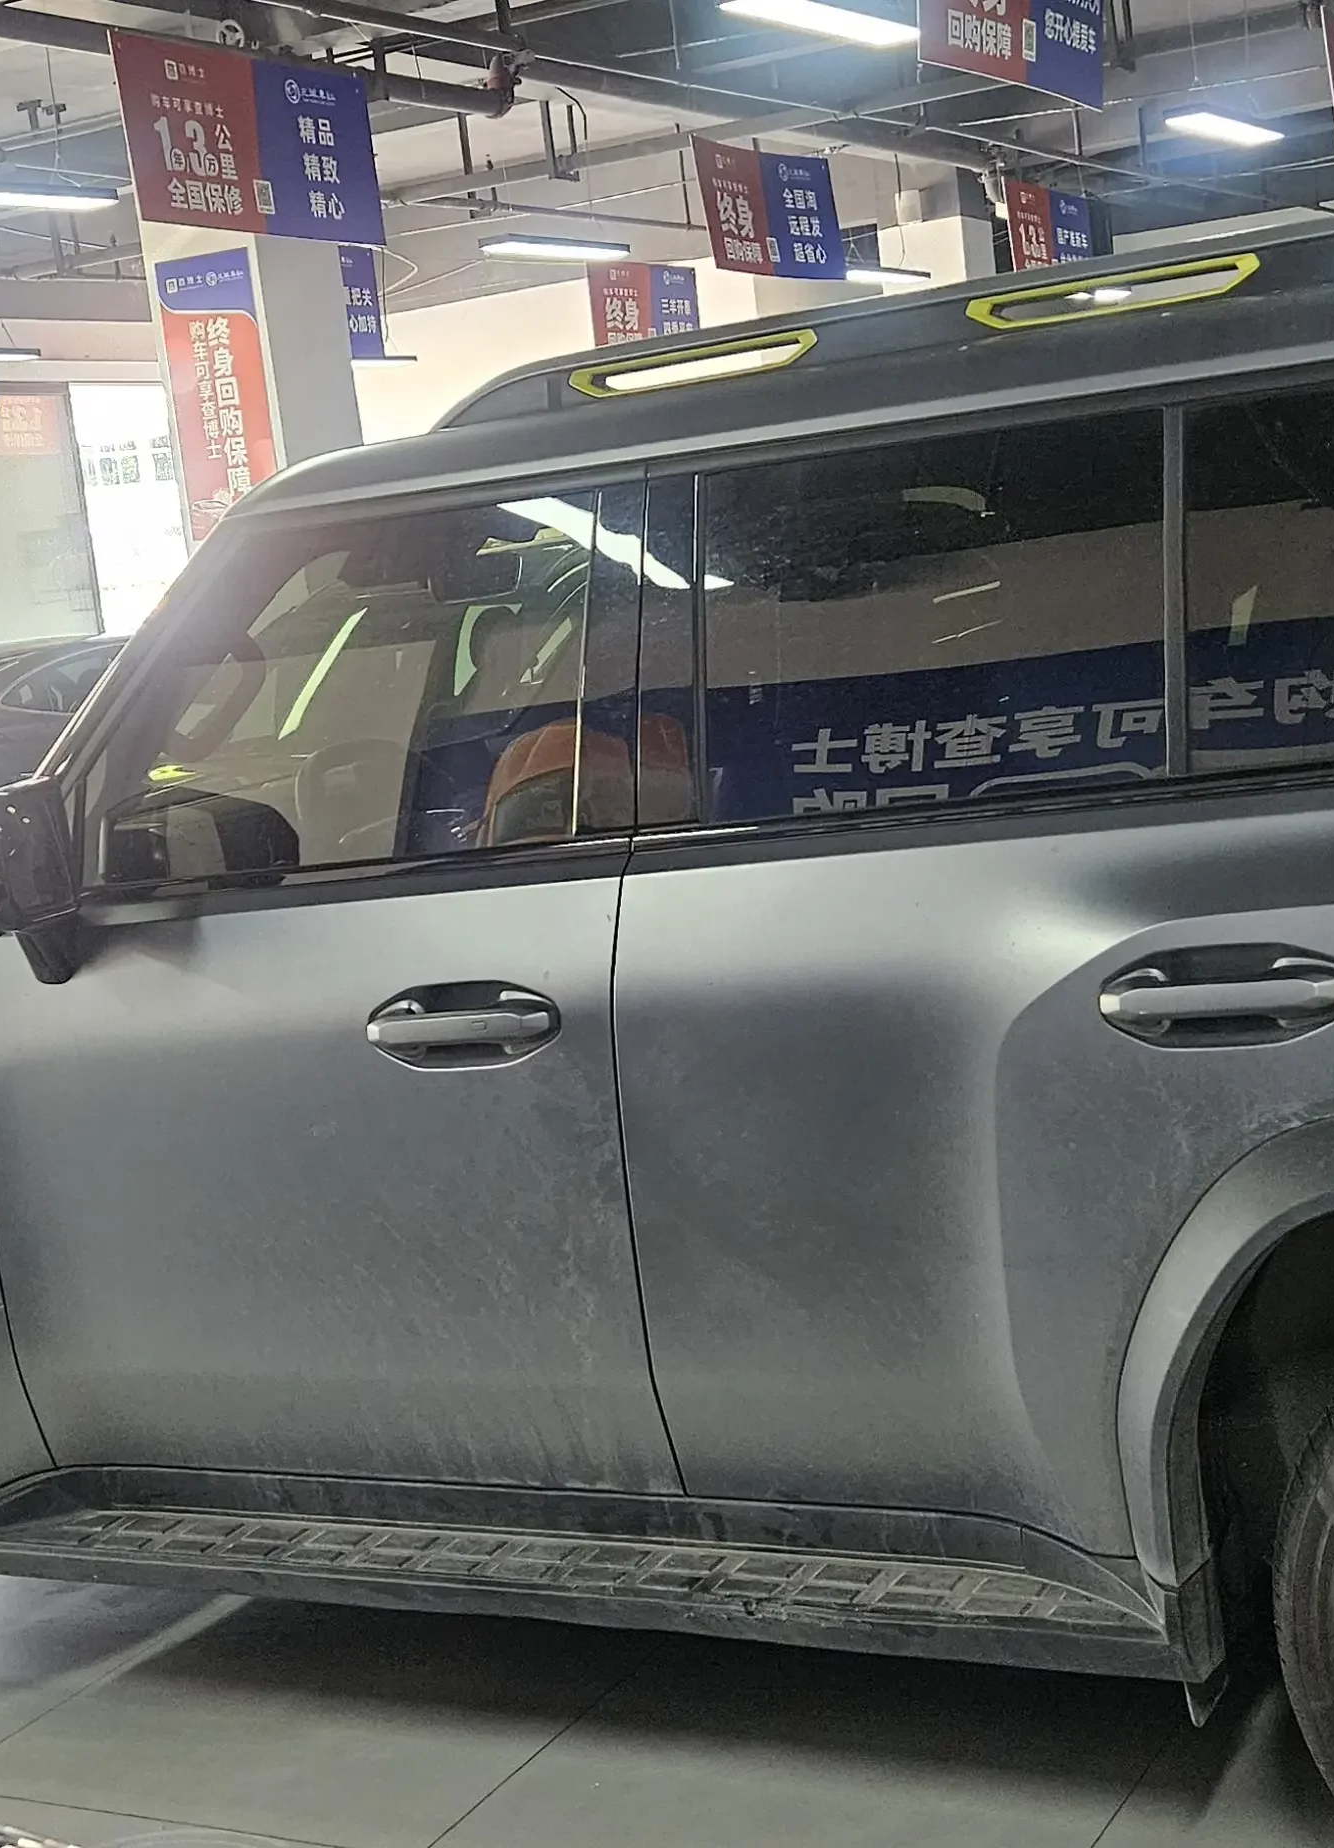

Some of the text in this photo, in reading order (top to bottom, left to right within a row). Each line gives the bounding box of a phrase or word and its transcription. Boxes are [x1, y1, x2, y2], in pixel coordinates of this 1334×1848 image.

[948, 8, 1012, 60] 回购保障
[297, 115, 336, 147] 精品
[302, 152, 341, 185] 精致
[167, 177, 244, 216] 全国保修
[308, 189, 346, 220] 精心
[716, 190, 754, 238] 终身
[605, 297, 640, 331] 终身
[188, 320, 223, 460] 购车可享查博士
[206, 316, 253, 497] 终身回购保障
